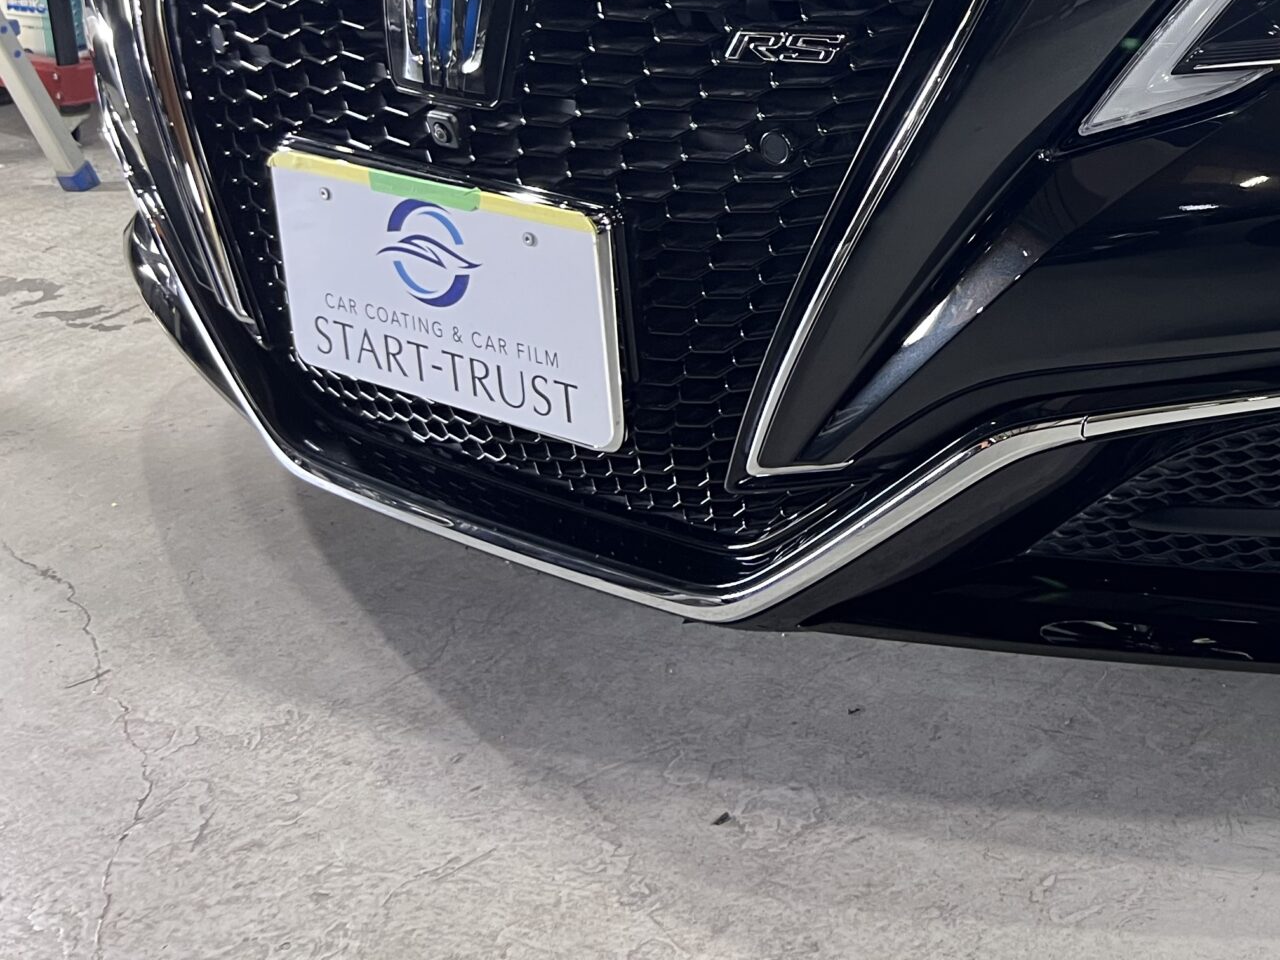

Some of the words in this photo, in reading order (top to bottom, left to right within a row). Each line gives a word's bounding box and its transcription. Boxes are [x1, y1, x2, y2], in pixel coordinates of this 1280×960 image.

[725, 31, 845, 64] RS
[325, 292, 357, 315] CAR
[365, 303, 443, 338] COATING
[452, 326, 463, 342] &
[471, 331, 507, 356] CAR
[517, 343, 559, 369] FILM
[314, 316, 578, 423] START-TRUST
